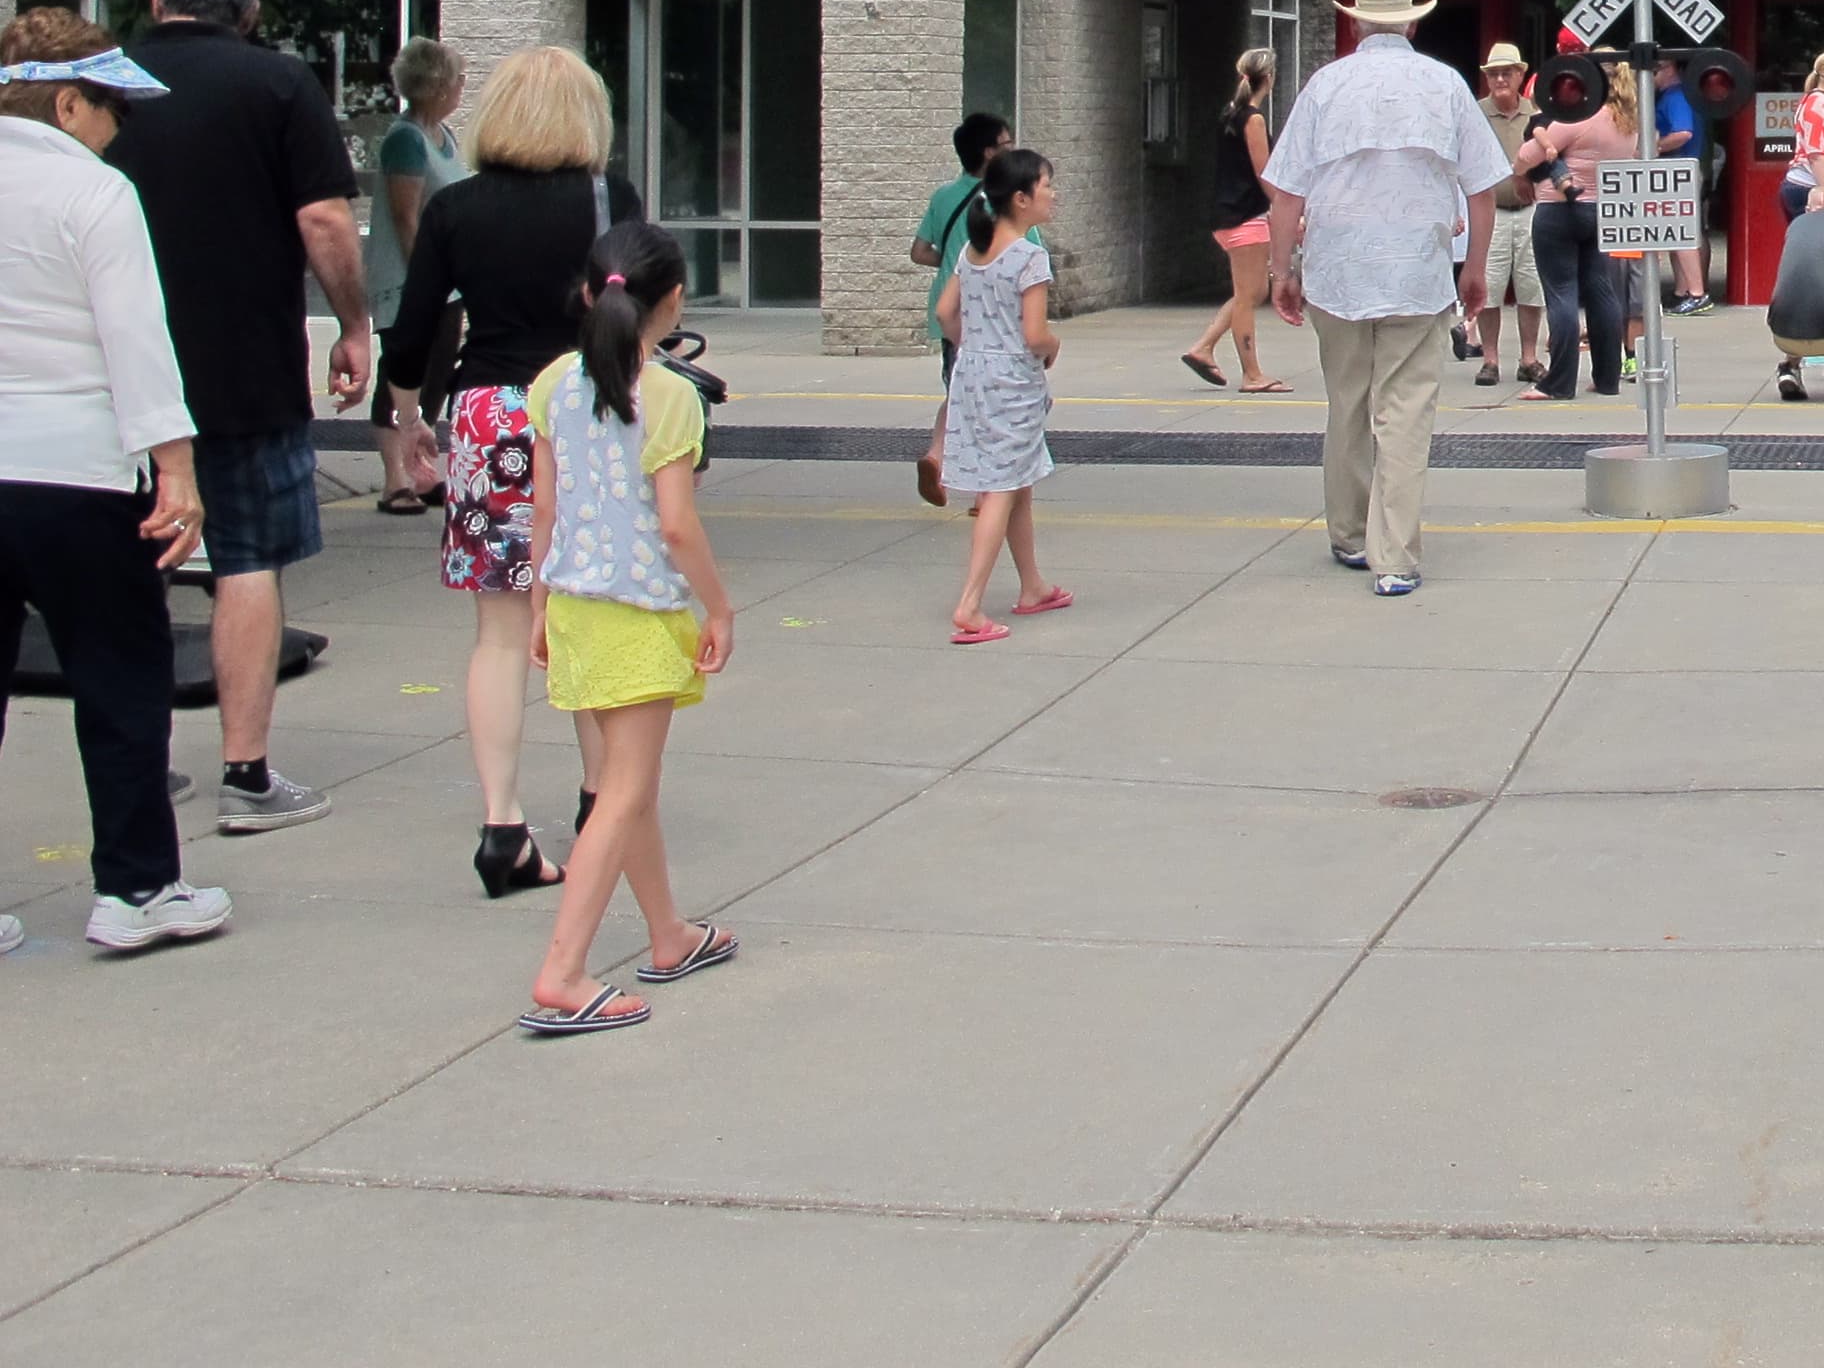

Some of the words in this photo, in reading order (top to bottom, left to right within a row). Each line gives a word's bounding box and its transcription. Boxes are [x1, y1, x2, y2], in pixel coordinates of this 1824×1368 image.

[1765, 99, 1800, 113] OPE
[1763, 143, 1793, 153] APRIL
[1602, 169, 1692, 194] STOP
[1601, 202, 1634, 218] ON
[1643, 200, 1694, 218] RED
[1602, 225, 1695, 243] SIGNAL
